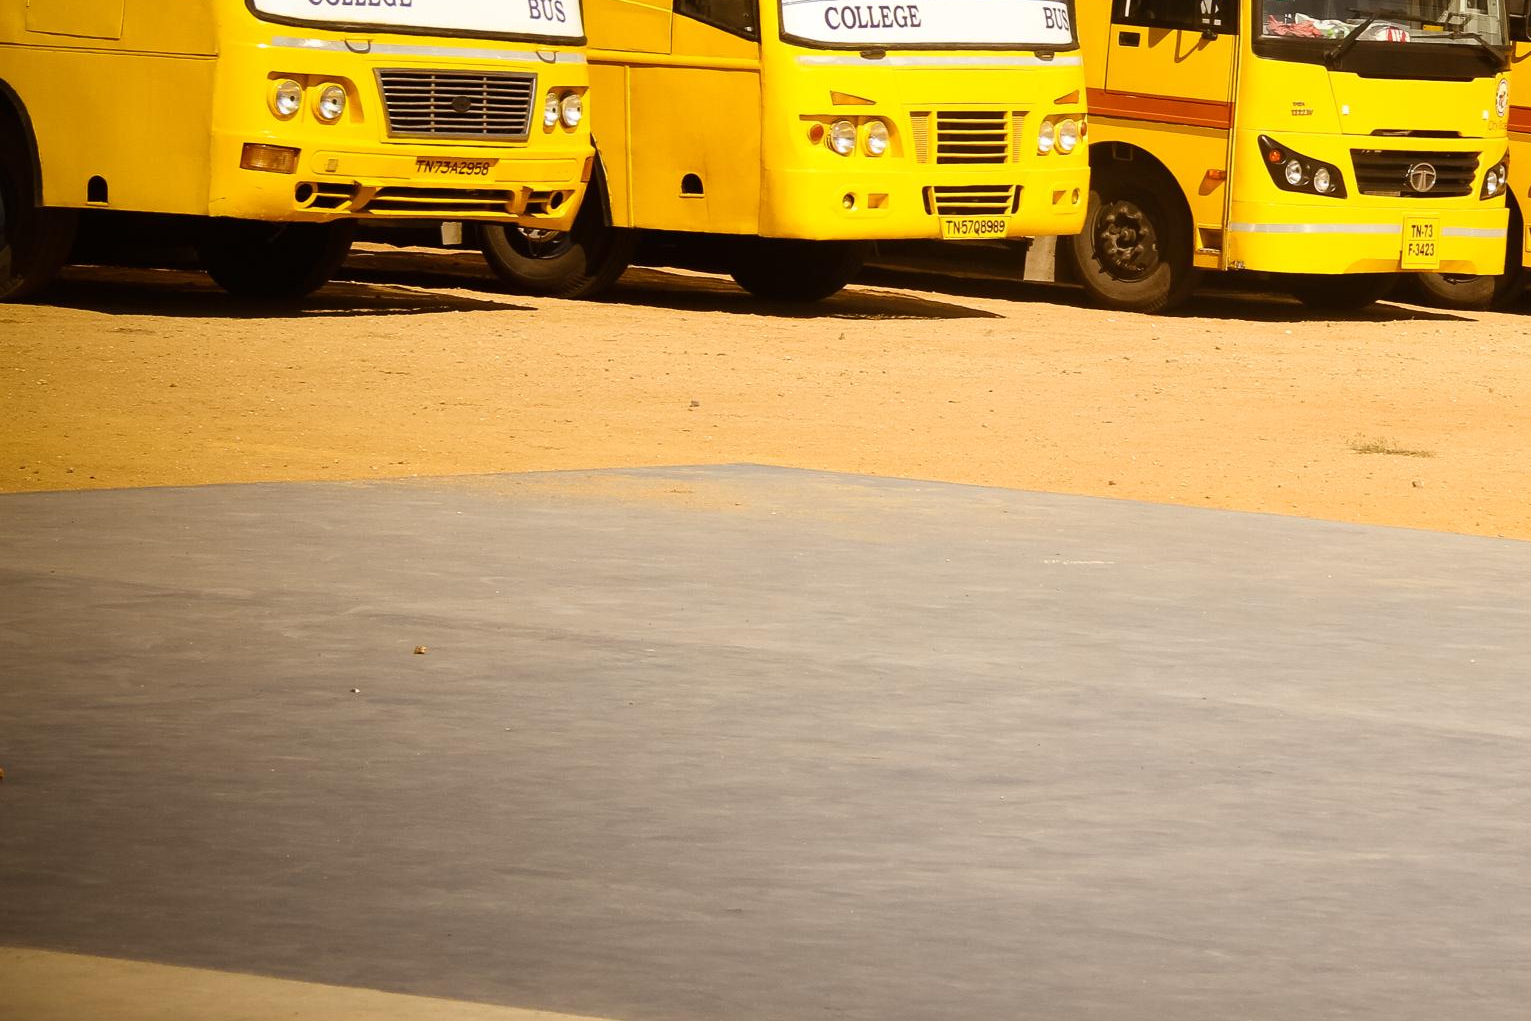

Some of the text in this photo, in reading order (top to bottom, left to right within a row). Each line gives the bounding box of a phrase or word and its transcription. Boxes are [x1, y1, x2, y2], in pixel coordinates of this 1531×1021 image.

[824, 5, 1070, 31] COLLEGE BUS
[1411, 224, 1433, 238] TN-73
[1408, 243, 1435, 257] F-3423
